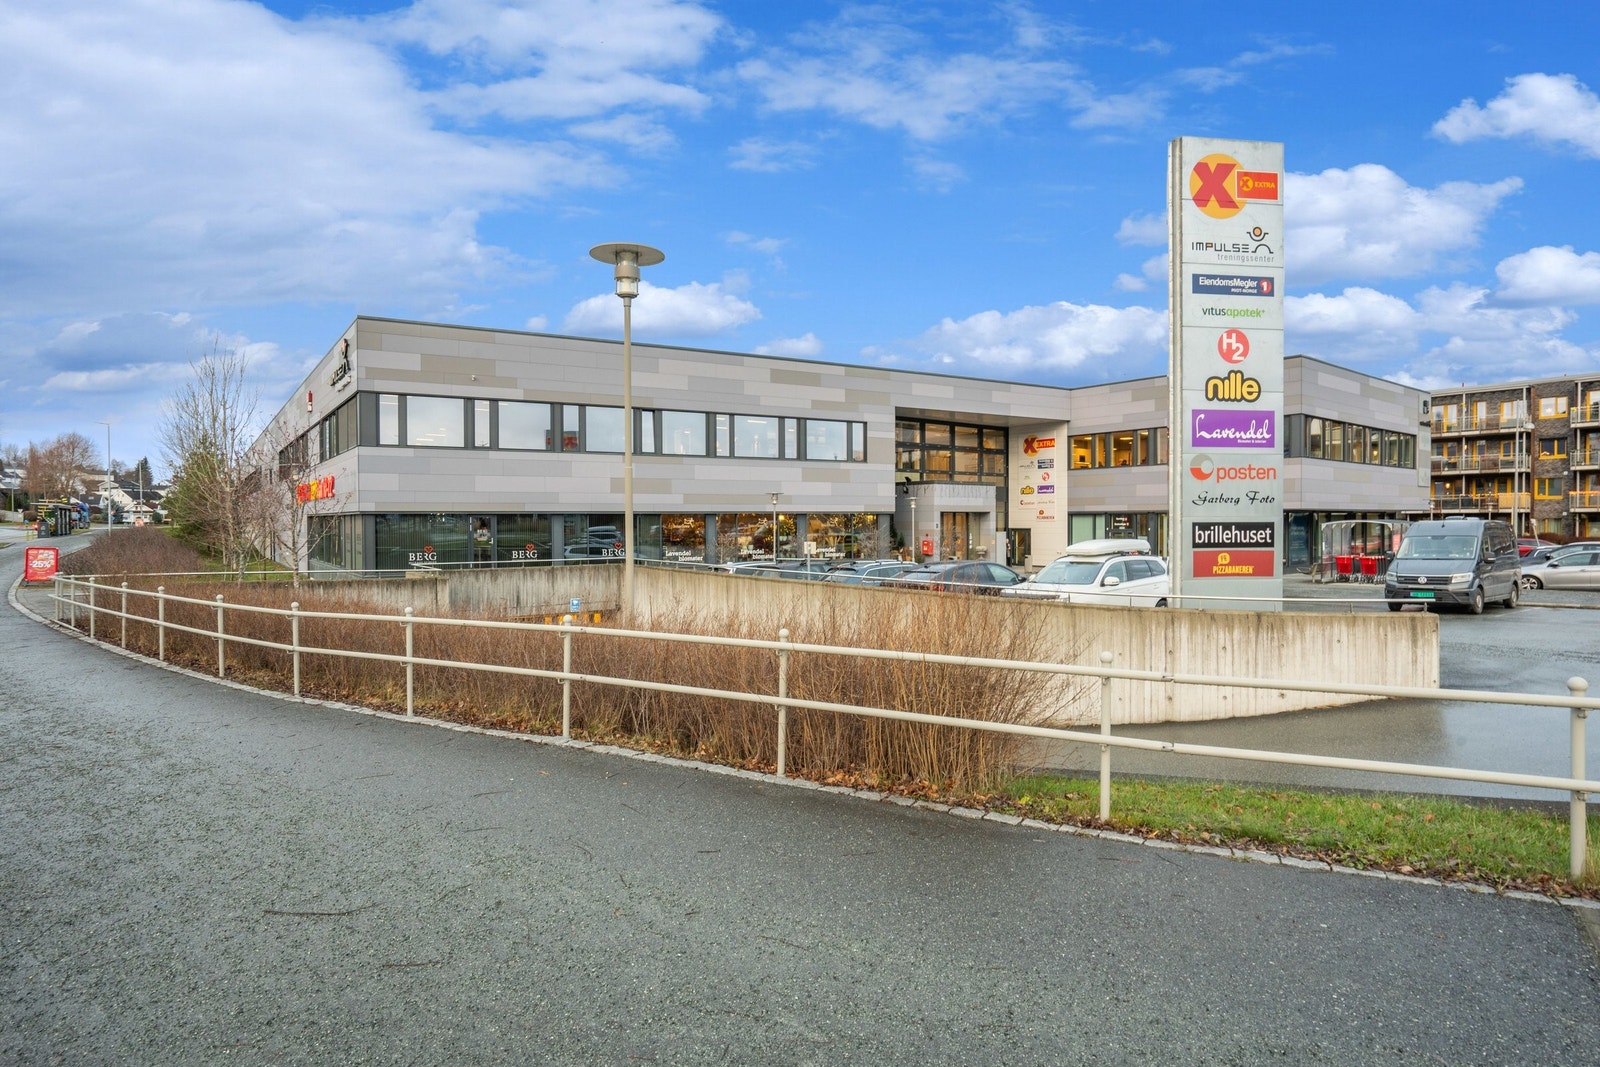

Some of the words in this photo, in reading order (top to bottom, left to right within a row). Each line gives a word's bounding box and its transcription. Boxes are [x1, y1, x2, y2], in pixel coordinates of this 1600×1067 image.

[1254, 181, 1275, 189] EXTRA
[1191, 241, 1250, 253] IMPULSE
[1217, 252, 1275, 263] treningssenter
[1199, 276, 1258, 288] EiendomsMegler
[1206, 371, 1261, 402] nille
[1196, 413, 1272, 439] Lavendel
[1036, 440, 1055, 448] EXTRA
[1216, 464, 1277, 483] posten
[1192, 490, 1241, 506] Garberg
[1245, 490, 1275, 506] Foto
[1195, 525, 1272, 544] brillehuset
[409, 552, 437, 561] BERG
[512, 550, 538, 559] BERG
[602, 548, 625, 557] BERG
